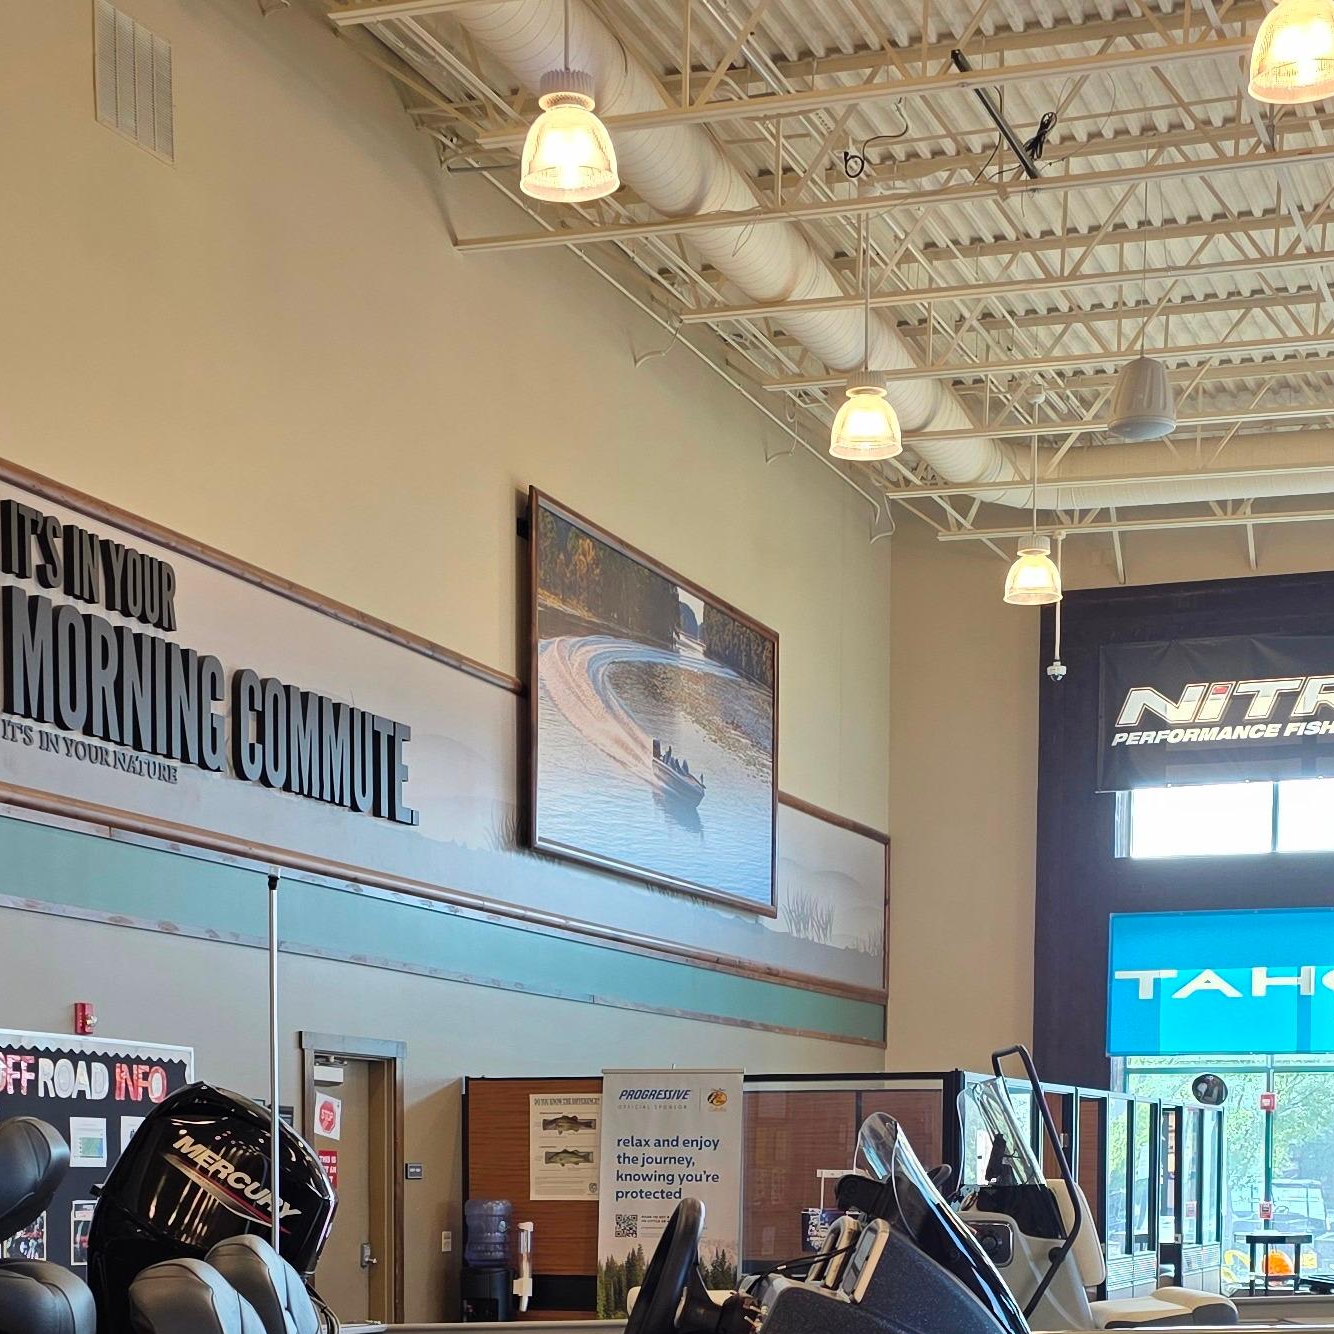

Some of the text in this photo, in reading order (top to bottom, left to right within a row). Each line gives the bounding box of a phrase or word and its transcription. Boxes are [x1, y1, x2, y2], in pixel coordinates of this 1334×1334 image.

[0, 499, 177, 632] IT'S IN YOUR
[2, 585, 225, 772] MORNING
[1112, 722, 1278, 746] PERFORMANCE
[0, 718, 178, 785] IT'S IN YOUR NATURE
[38, 1057, 109, 1100] ROAD
[115, 1062, 168, 1104] INFO
[619, 1089, 691, 1100] PROGRESSIVE
[321, 1109, 334, 1121] STOP
[617, 1136, 719, 1150] relax and enjoy
[617, 1153, 695, 1167] the journey,
[173, 1135, 302, 1219] MERCURY
[616, 1170, 719, 1185] knowing you're
[616, 1188, 682, 1202] protected
